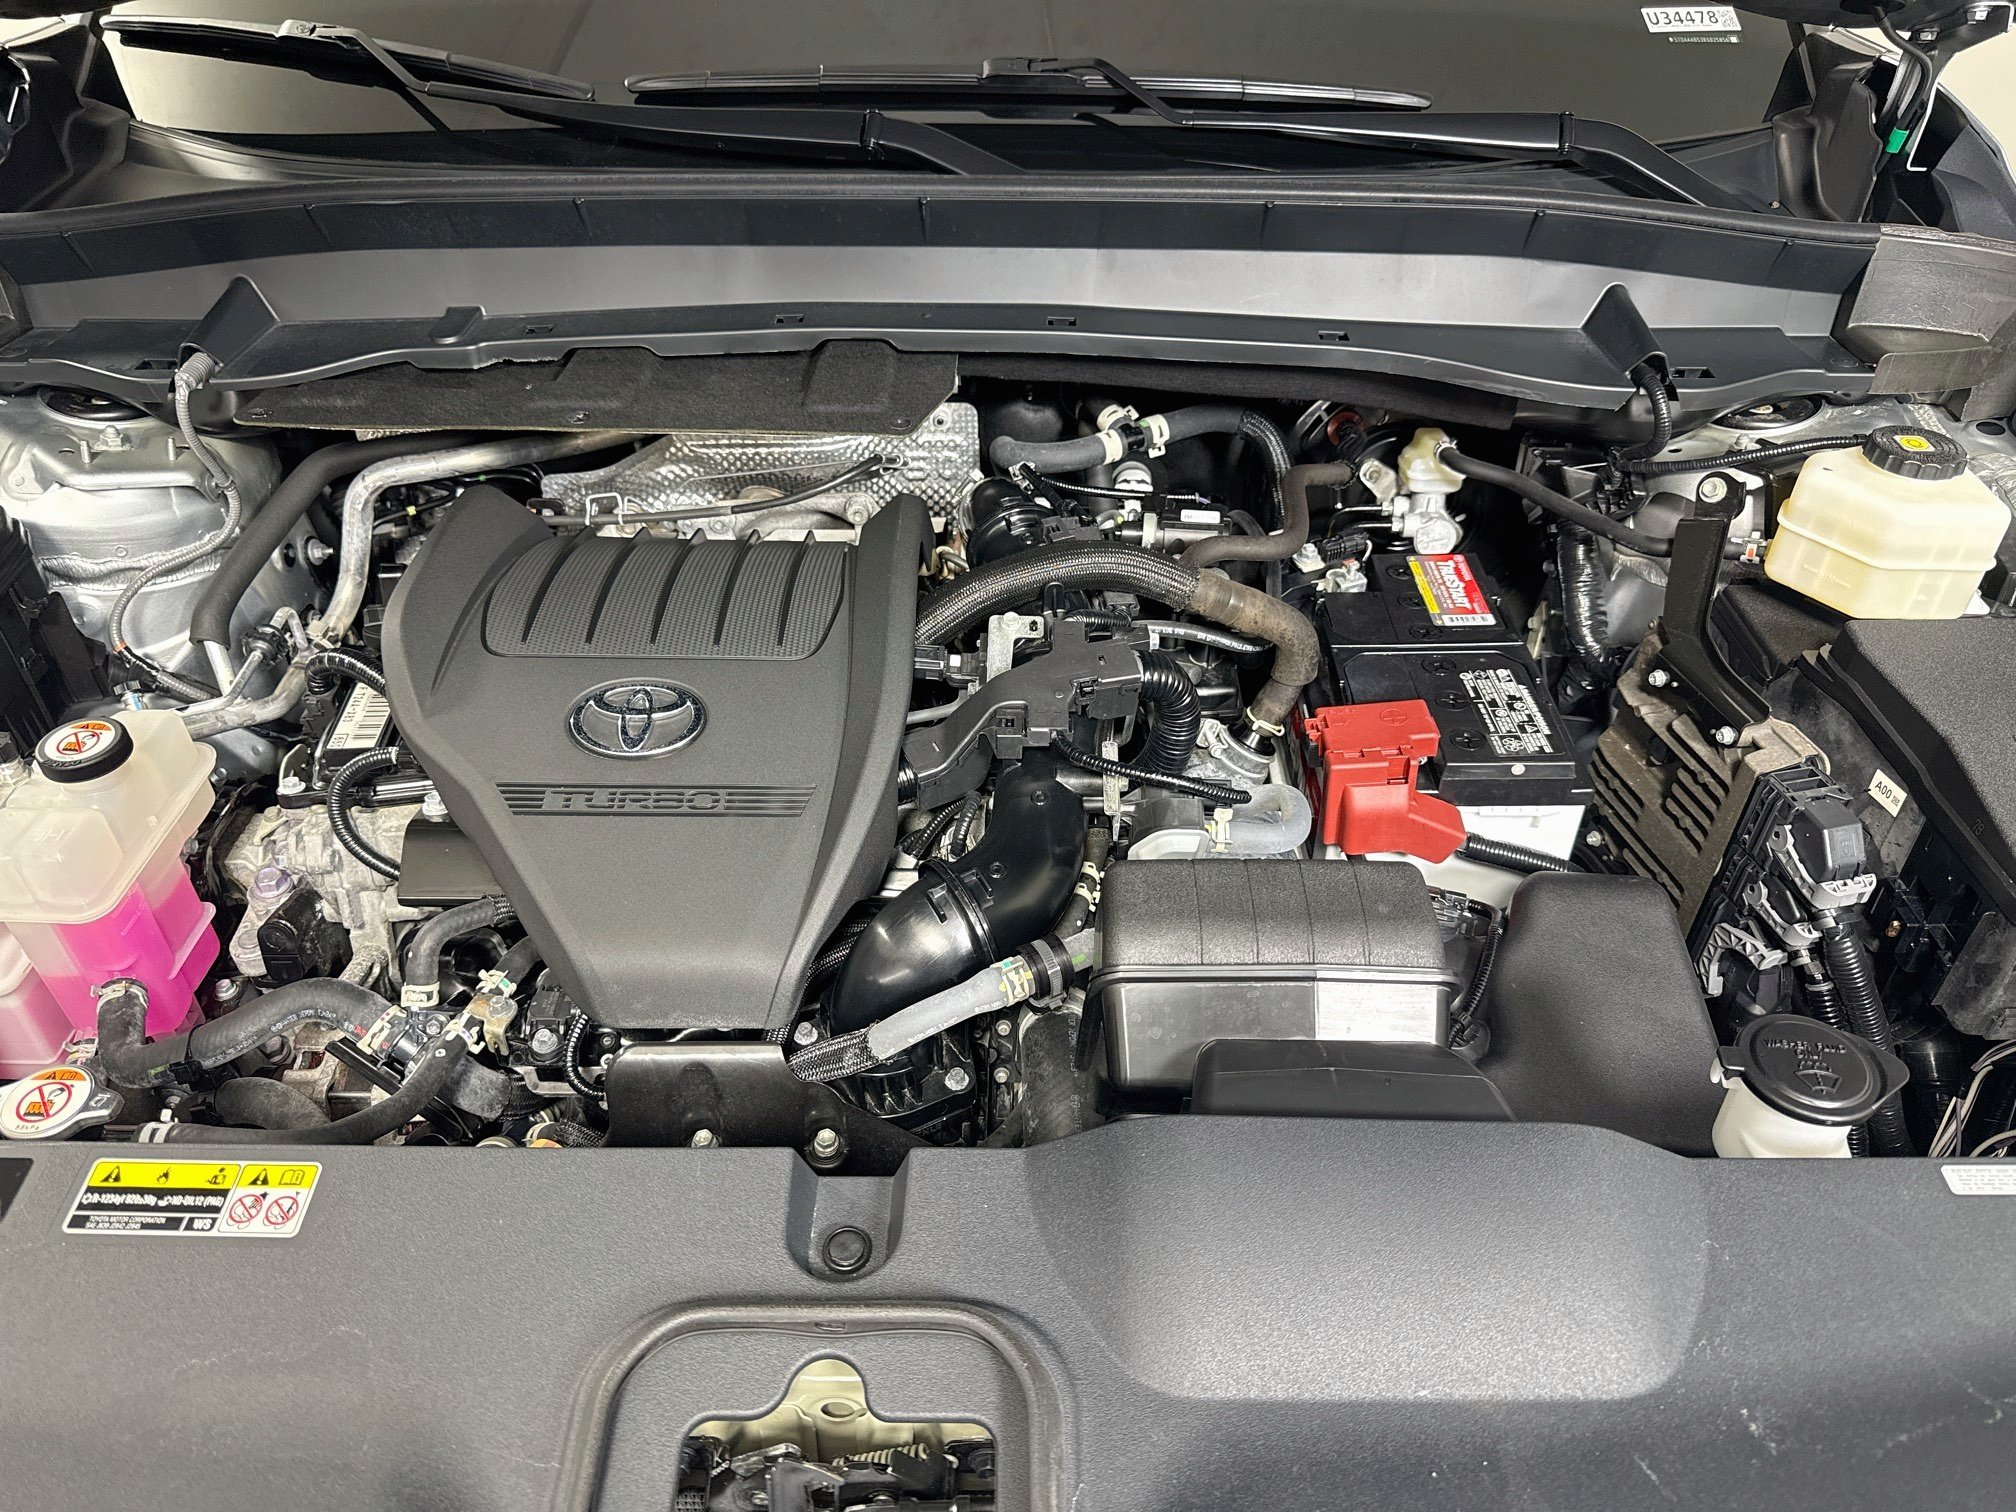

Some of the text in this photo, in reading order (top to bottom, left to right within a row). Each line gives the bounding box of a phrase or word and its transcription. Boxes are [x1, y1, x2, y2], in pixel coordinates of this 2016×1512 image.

[1646, 10, 1719, 25] U34478
[551, 789, 721, 810] TURBO
[1763, 1038, 1847, 1054] WASHER FLUID
[1795, 1048, 1823, 1060] ONLY
[129, 1216, 167, 1224] CORPORATION
[193, 1218, 212, 1229] WS
